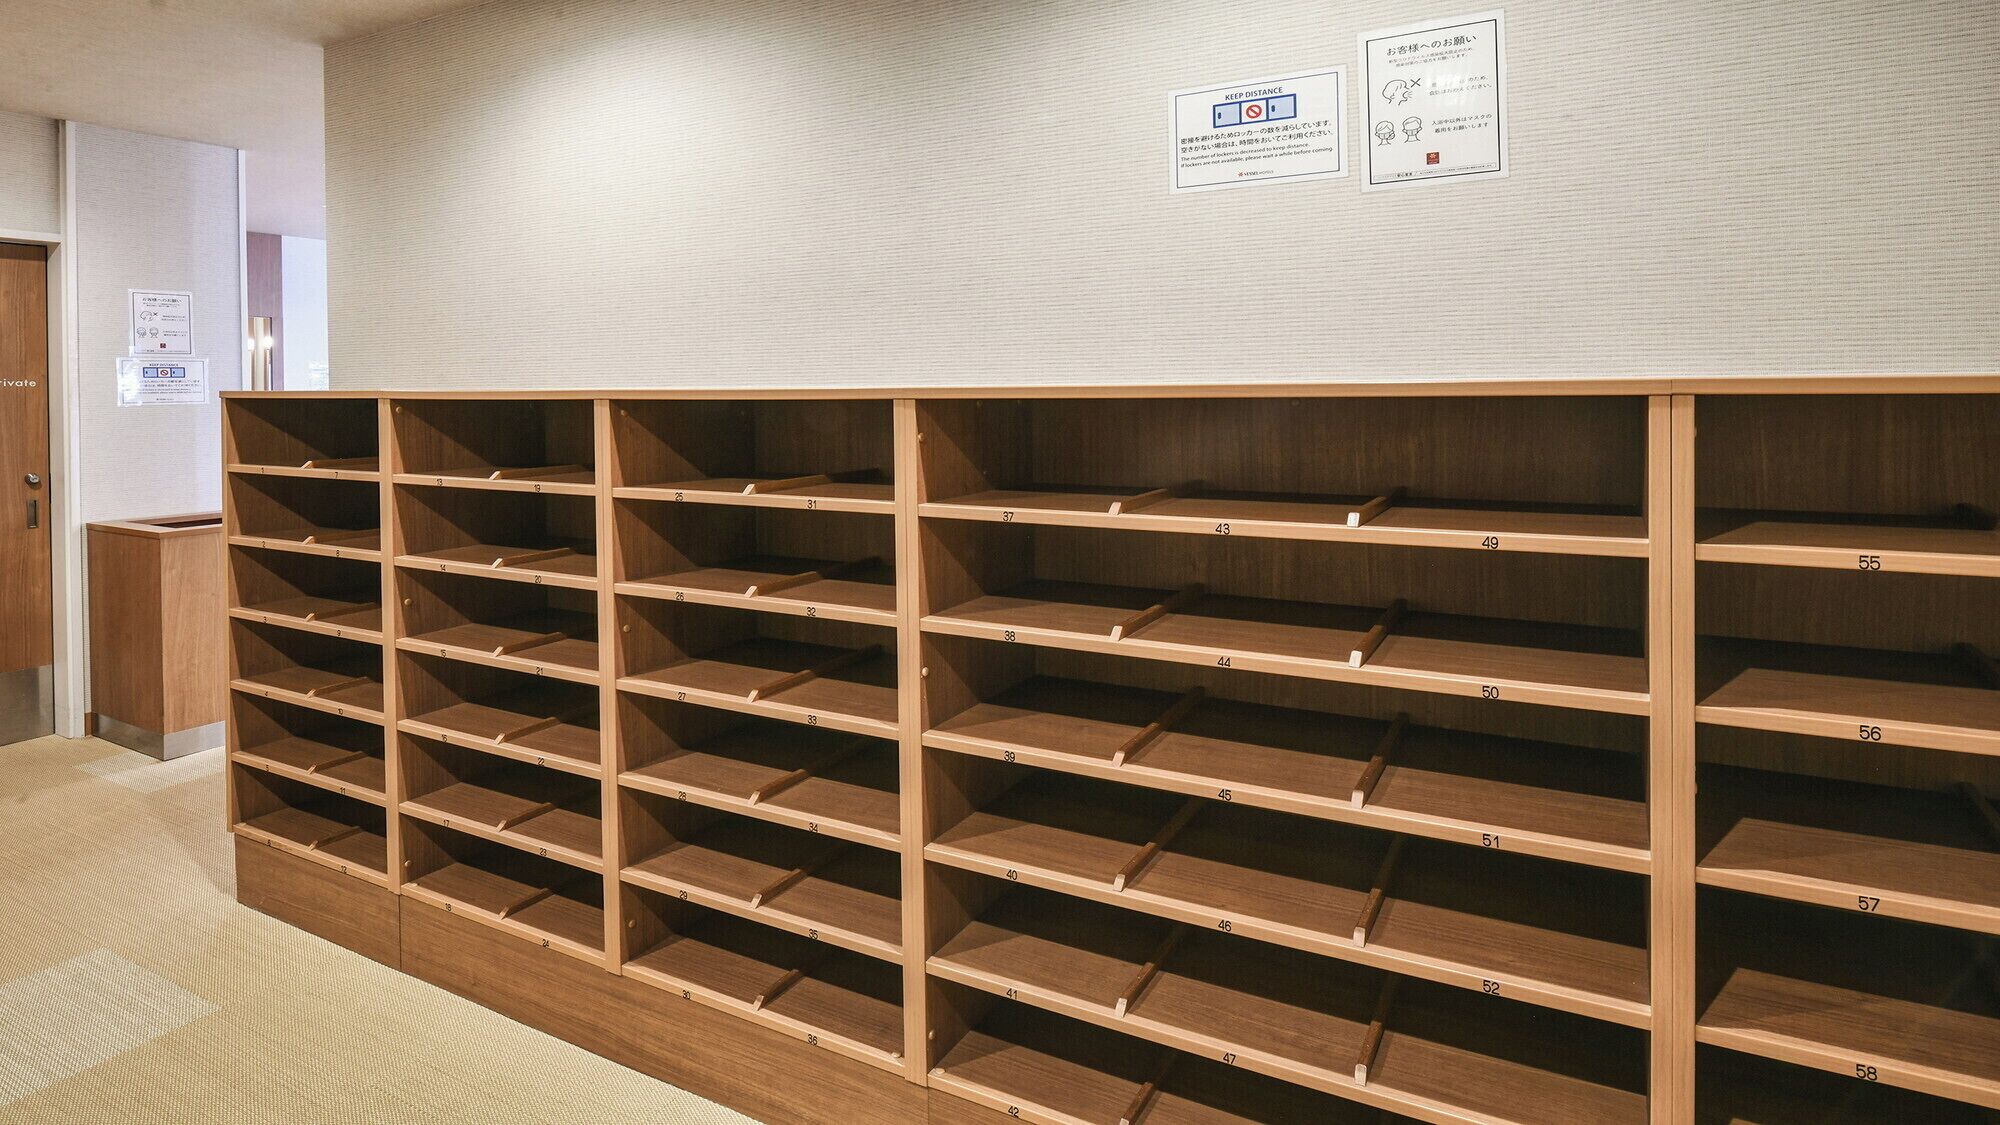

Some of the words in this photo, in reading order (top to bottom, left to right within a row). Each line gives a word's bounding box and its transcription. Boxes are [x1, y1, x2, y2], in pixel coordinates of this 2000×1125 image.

[1386, 35, 1477, 56] お客様へのお願い
[1225, 92, 1244, 101] KEEP
[1245, 86, 1283, 98] DISTANCE
[675, 492, 683, 501] 25
[807, 499, 817, 509] 31
[1002, 511, 1014, 522] 37
[1215, 523, 1231, 535] 43
[1481, 536, 1499, 550] 49
[1858, 555, 1881, 571] 55
[676, 591, 684, 601] 26
[807, 606, 816, 616] 32
[1004, 630, 1016, 642] 38
[1217, 656, 1231, 668] 44
[535, 666, 543, 675] 21
[678, 691, 686, 701] 27
[1482, 685, 1500, 699] 50
[807, 714, 817, 725] 33
[1859, 725, 1882, 741] 56
[1004, 750, 1016, 763] 39
[678, 791, 686, 801] 28
[1217, 788, 1232, 801] 45
[808, 822, 818, 833] 34
[1482, 833, 1500, 849] 51
[1006, 869, 1018, 880] 40
[680, 890, 688, 900] 29
[1858, 895, 1881, 911] 57
[1217, 919, 1232, 932] 46
[808, 928, 819, 940] 35
[1482, 979, 1500, 995] 52
[682, 989, 691, 1000] 30
[1006, 988, 1018, 1000] 41
[807, 1033, 818, 1046] 36
[1222, 1052, 1237, 1065] 47
[1855, 1063, 1878, 1081] 58
[1007, 1105, 1020, 1119] 42
